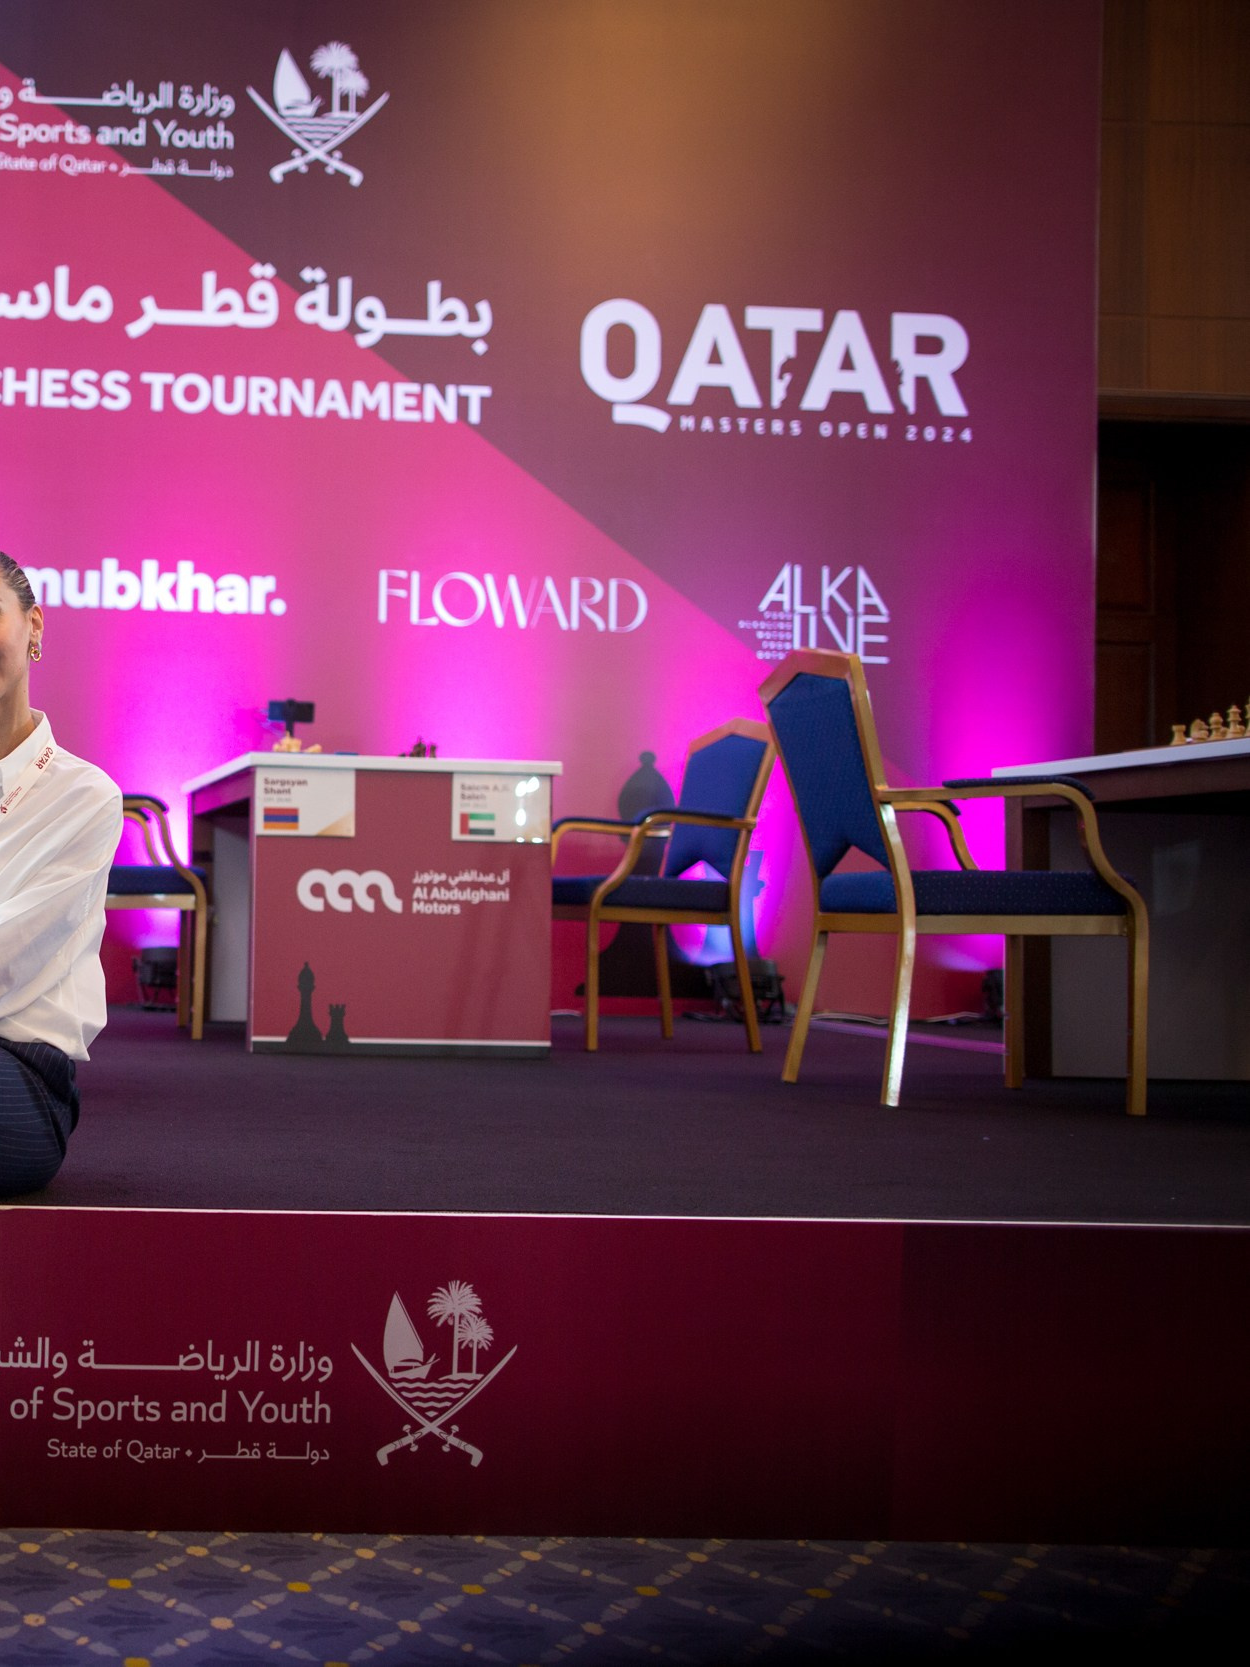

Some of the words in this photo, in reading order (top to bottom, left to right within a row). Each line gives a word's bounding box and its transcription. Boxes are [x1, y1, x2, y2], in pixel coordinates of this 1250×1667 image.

[18, 78, 173, 114] الرياضة
[178, 84, 235, 118] وزارة
[96, 119, 146, 146] and
[153, 120, 234, 149] Youth
[39, 154, 57, 171] of
[59, 154, 107, 176] Qatar
[125, 263, 279, 338] قطر
[295, 267, 492, 355] بطولة
[580, 298, 970, 434] QATAR
[140, 372, 491, 424] TOURNAMENT
[680, 415, 801, 436] MASTERS
[819, 422, 887, 439] OPEN
[906, 425, 971, 442] 2024
[22, 558, 286, 615] mubkhar.
[376, 568, 650, 634] FLOWARD
[757, 562, 890, 614] ALKA
[35, 746, 54, 770] QATAR
[264, 787, 291, 795] Shant
[413, 871, 447, 884] موتورز
[448, 870, 495, 888] عبدالغني
[495, 869, 509, 885] آل
[412, 901, 460, 914] Motors
[413, 887, 428, 899] Al
[430, 887, 509, 904] Abdulghani
[78, 1340, 259, 1381] الرياضة
[270, 1341, 333, 1382] وزارة
[10, 1386, 44, 1419] of
[53, 1387, 160, 1429] Sports
[171, 1390, 226, 1422] and
[238, 1391, 330, 1423] Youth
[47, 1439, 97, 1458] State
[103, 1439, 122, 1458] of
[127, 1440, 180, 1463] Qatar
[198, 1441, 261, 1463] قطر
[266, 1442, 329, 1465] دولة
